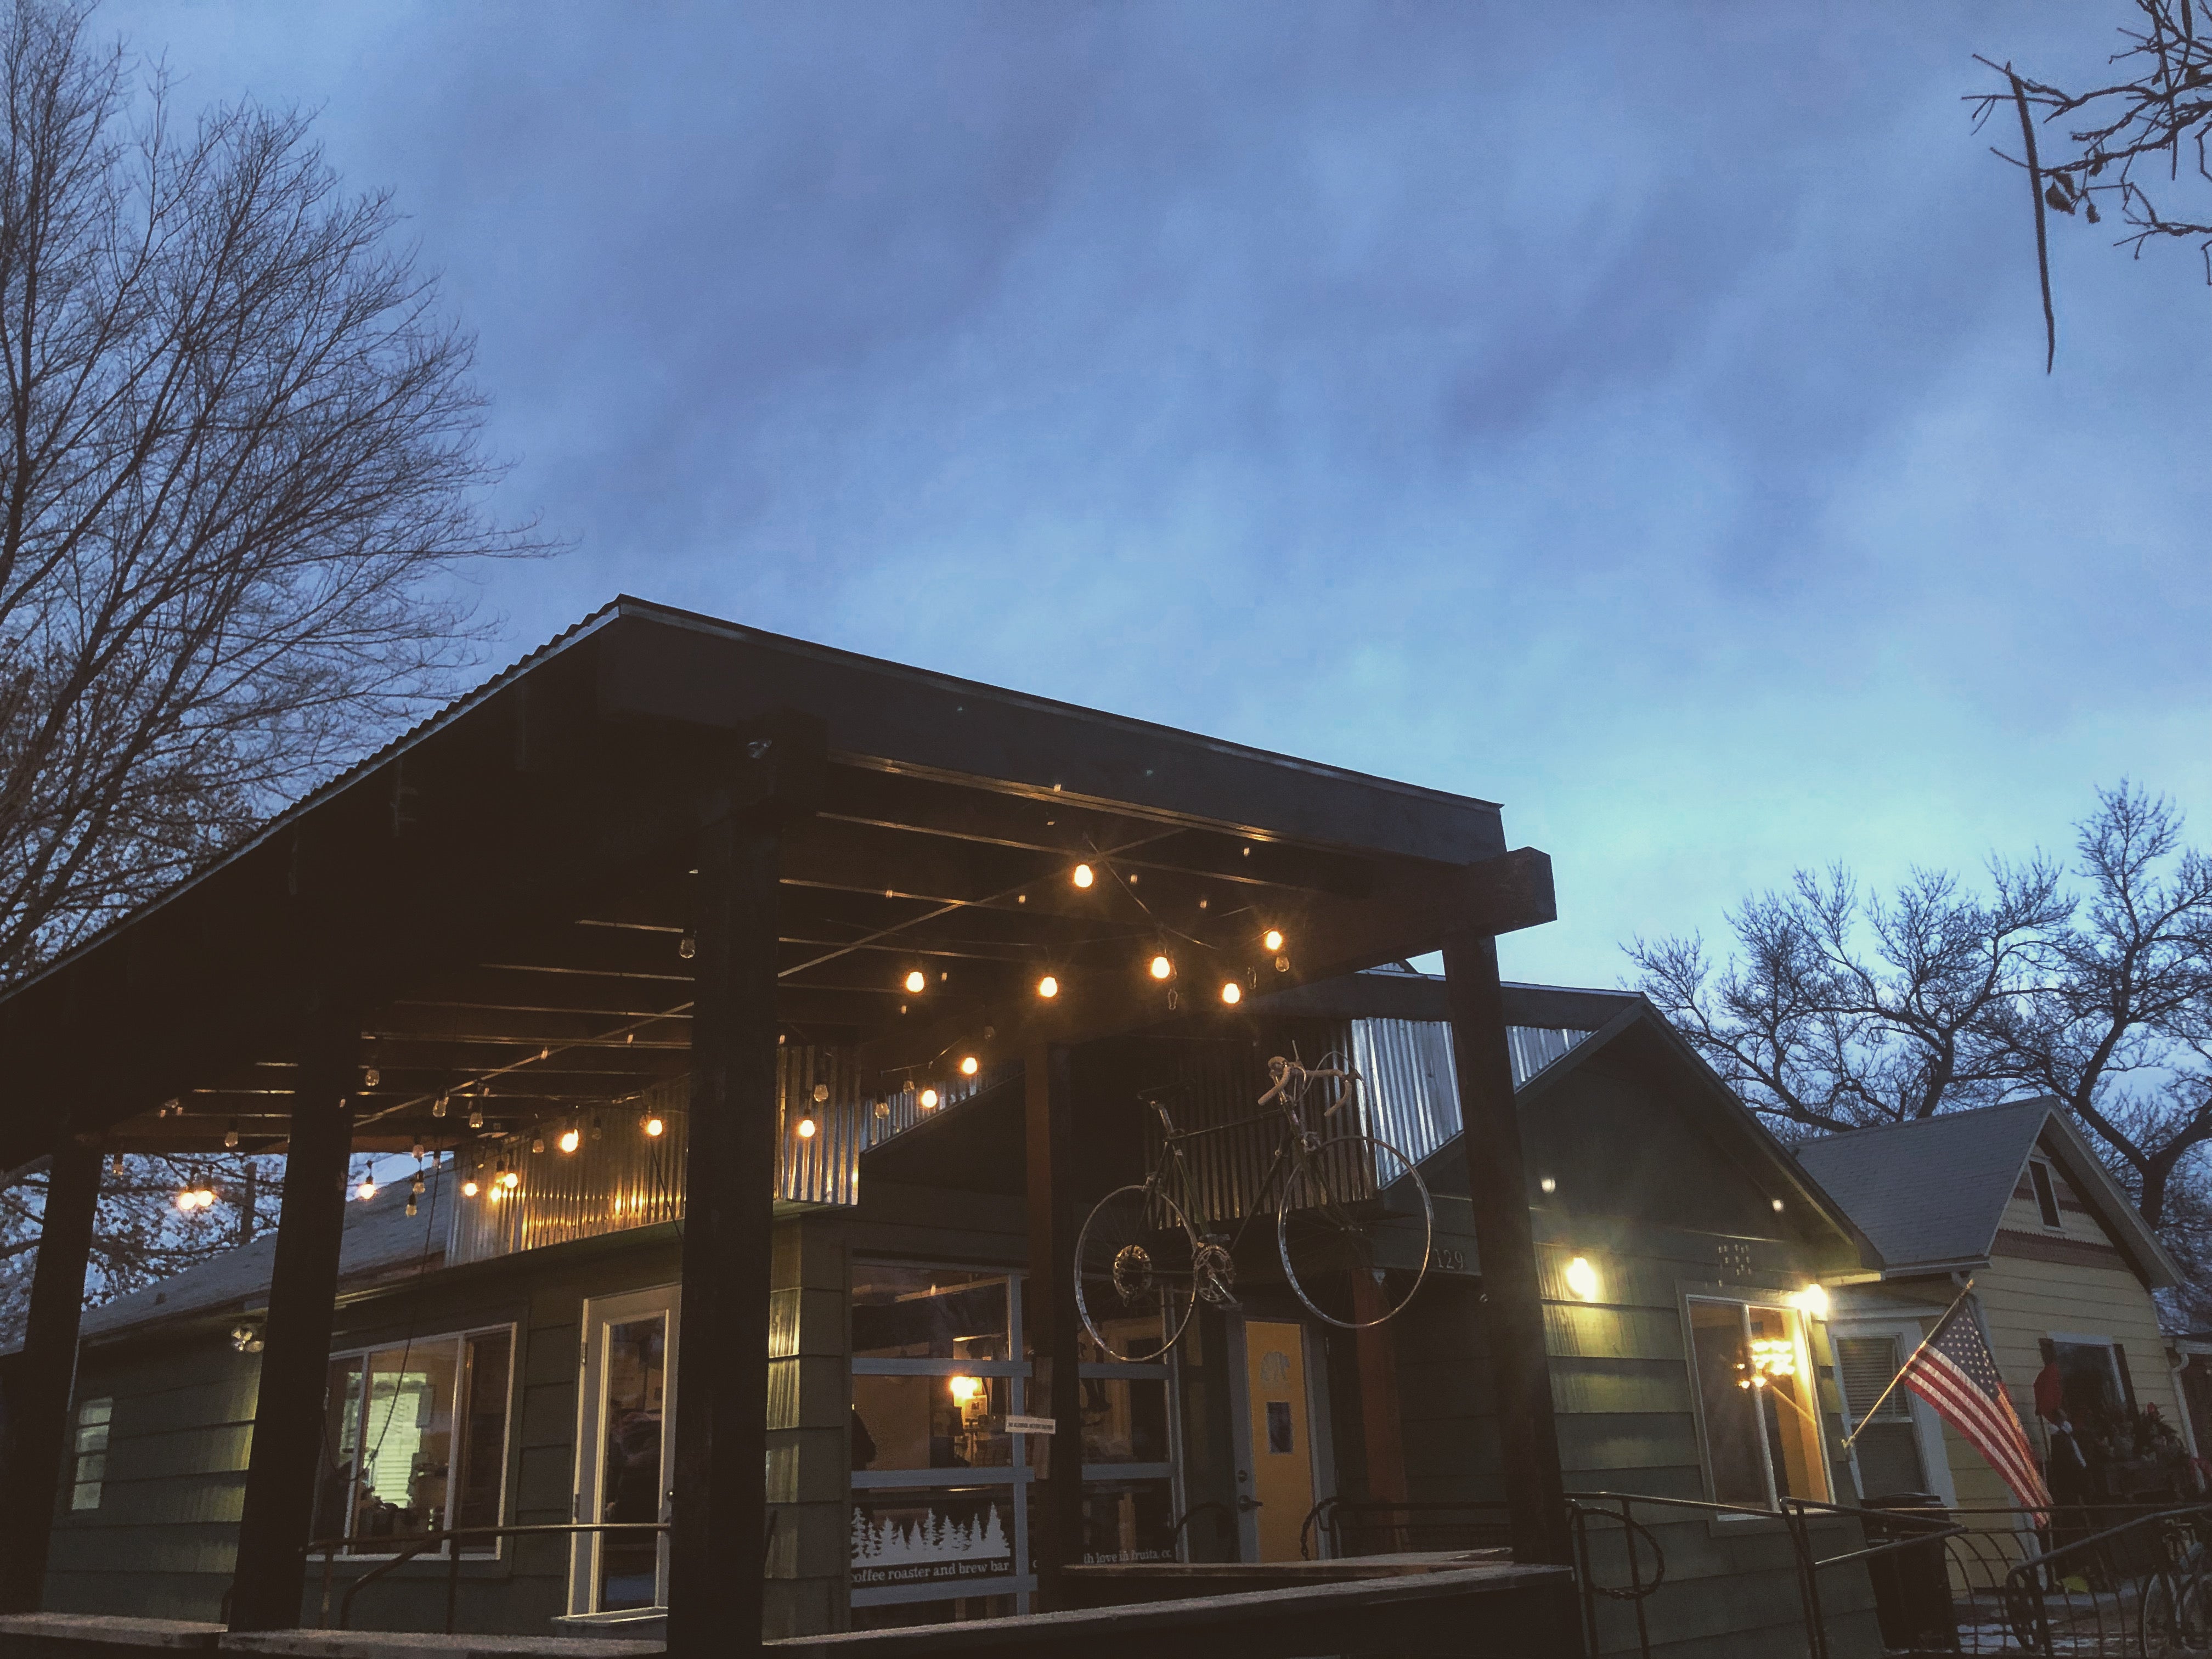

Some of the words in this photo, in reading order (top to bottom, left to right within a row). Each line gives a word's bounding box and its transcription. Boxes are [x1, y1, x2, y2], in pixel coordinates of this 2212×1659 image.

[1434, 1249, 1463, 1269] 129
[1096, 1552, 1117, 1563] love
[1119, 1550, 1129, 1561] in
[852, 1569, 885, 1582] offee
[888, 1566, 930, 1579] roaster
[933, 1563, 956, 1576] and
[959, 1562, 988, 1574] brew
[991, 1560, 1009, 1572] bar
